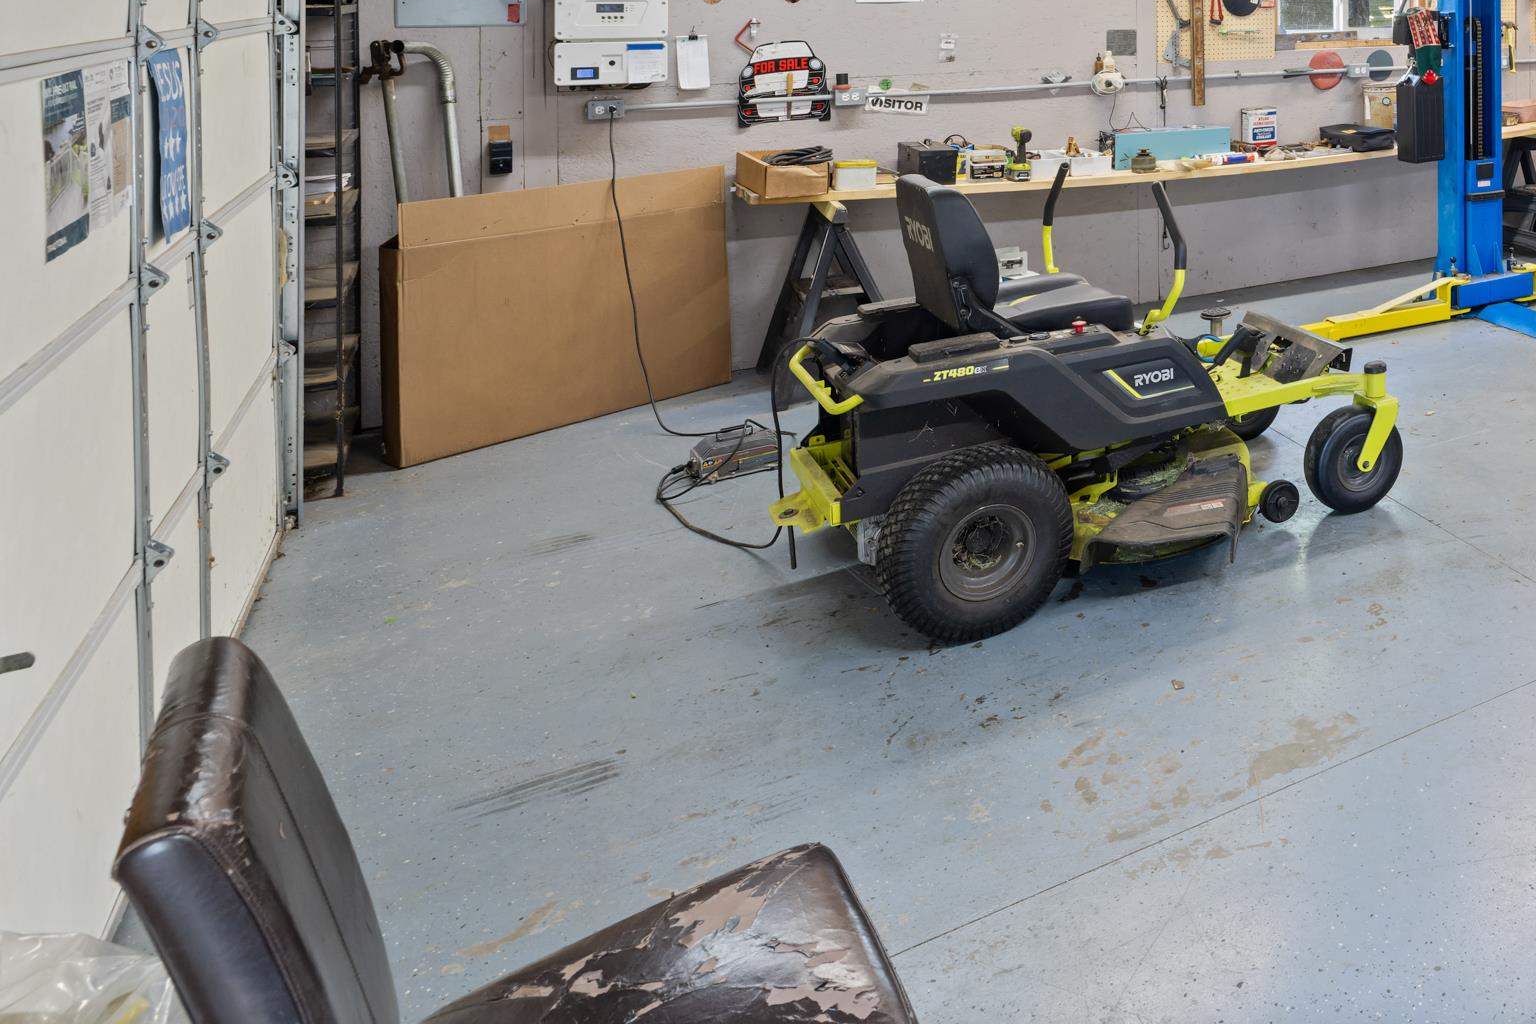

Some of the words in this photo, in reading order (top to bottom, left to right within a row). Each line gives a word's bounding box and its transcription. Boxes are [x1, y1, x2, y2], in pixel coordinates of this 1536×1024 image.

[754, 60, 775, 74] FOR
[779, 57, 808, 72] SALE
[871, 96, 923, 112] VISITOR
[904, 216, 934, 252] RYOBI
[1133, 368, 1174, 387] RYOBI
